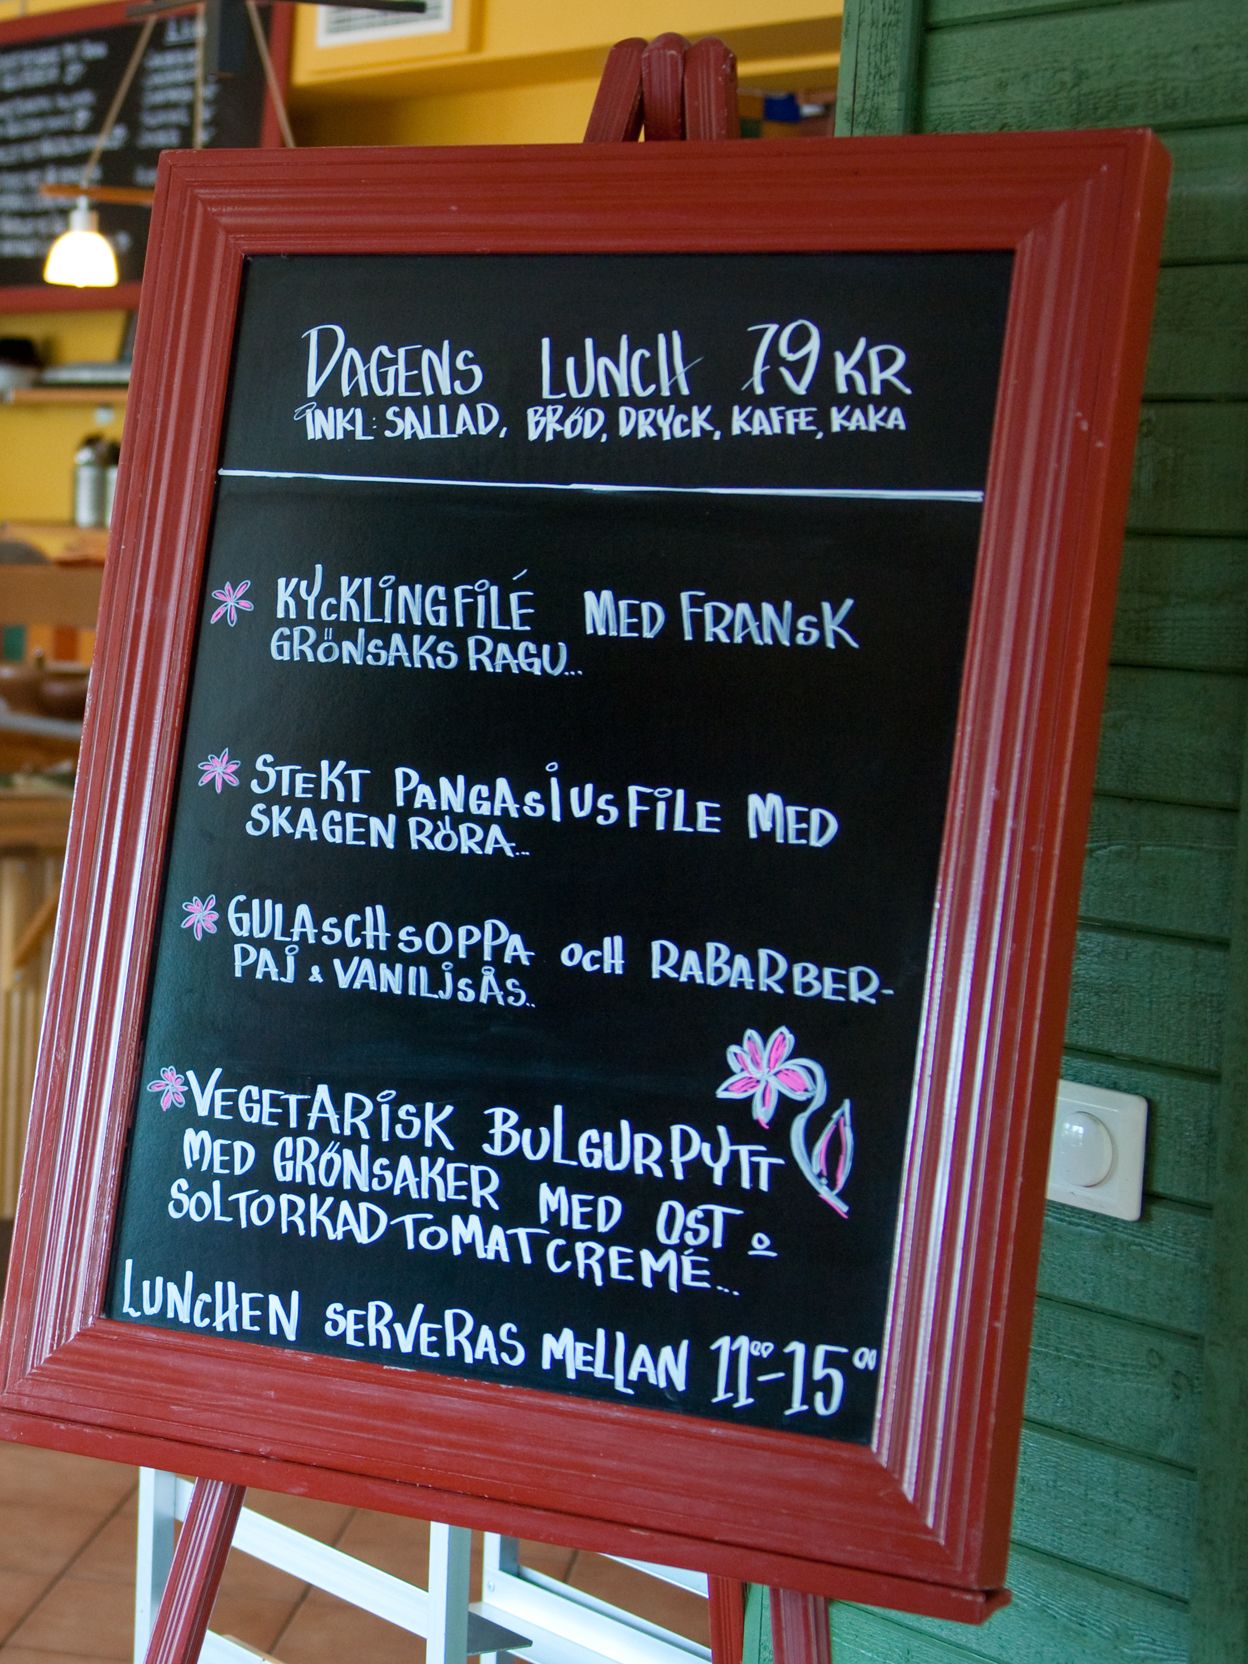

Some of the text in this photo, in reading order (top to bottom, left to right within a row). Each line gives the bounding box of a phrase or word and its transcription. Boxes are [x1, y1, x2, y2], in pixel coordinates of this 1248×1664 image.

[301, 318, 913, 400] DAGENS LUNCH 79 KR
[383, 402, 508, 441] SALLAD,
[526, 404, 609, 444] BRÖD,
[617, 403, 722, 442] DRYCK,
[731, 404, 825, 441] KAFFE,
[829, 403, 908, 434] KAKA
[583, 588, 666, 640] MED
[679, 589, 860, 651] FRANSK
[250, 753, 372, 804] STEKT
[747, 792, 840, 849] MED
[232, 943, 300, 984] PAJ
[308, 965, 324, 984] &
[185, 1066, 456, 1152] VEGETARISK
[182, 1127, 257, 1177] MED
[272, 1135, 501, 1212] GRÖNSAKER
[538, 1181, 624, 1234] MED
[655, 1199, 746, 1250] OST
[122, 1258, 300, 1342] LUNCHEN
[324, 1300, 527, 1367] SERVERAS
[540, 1326, 690, 1396] MELLAN
